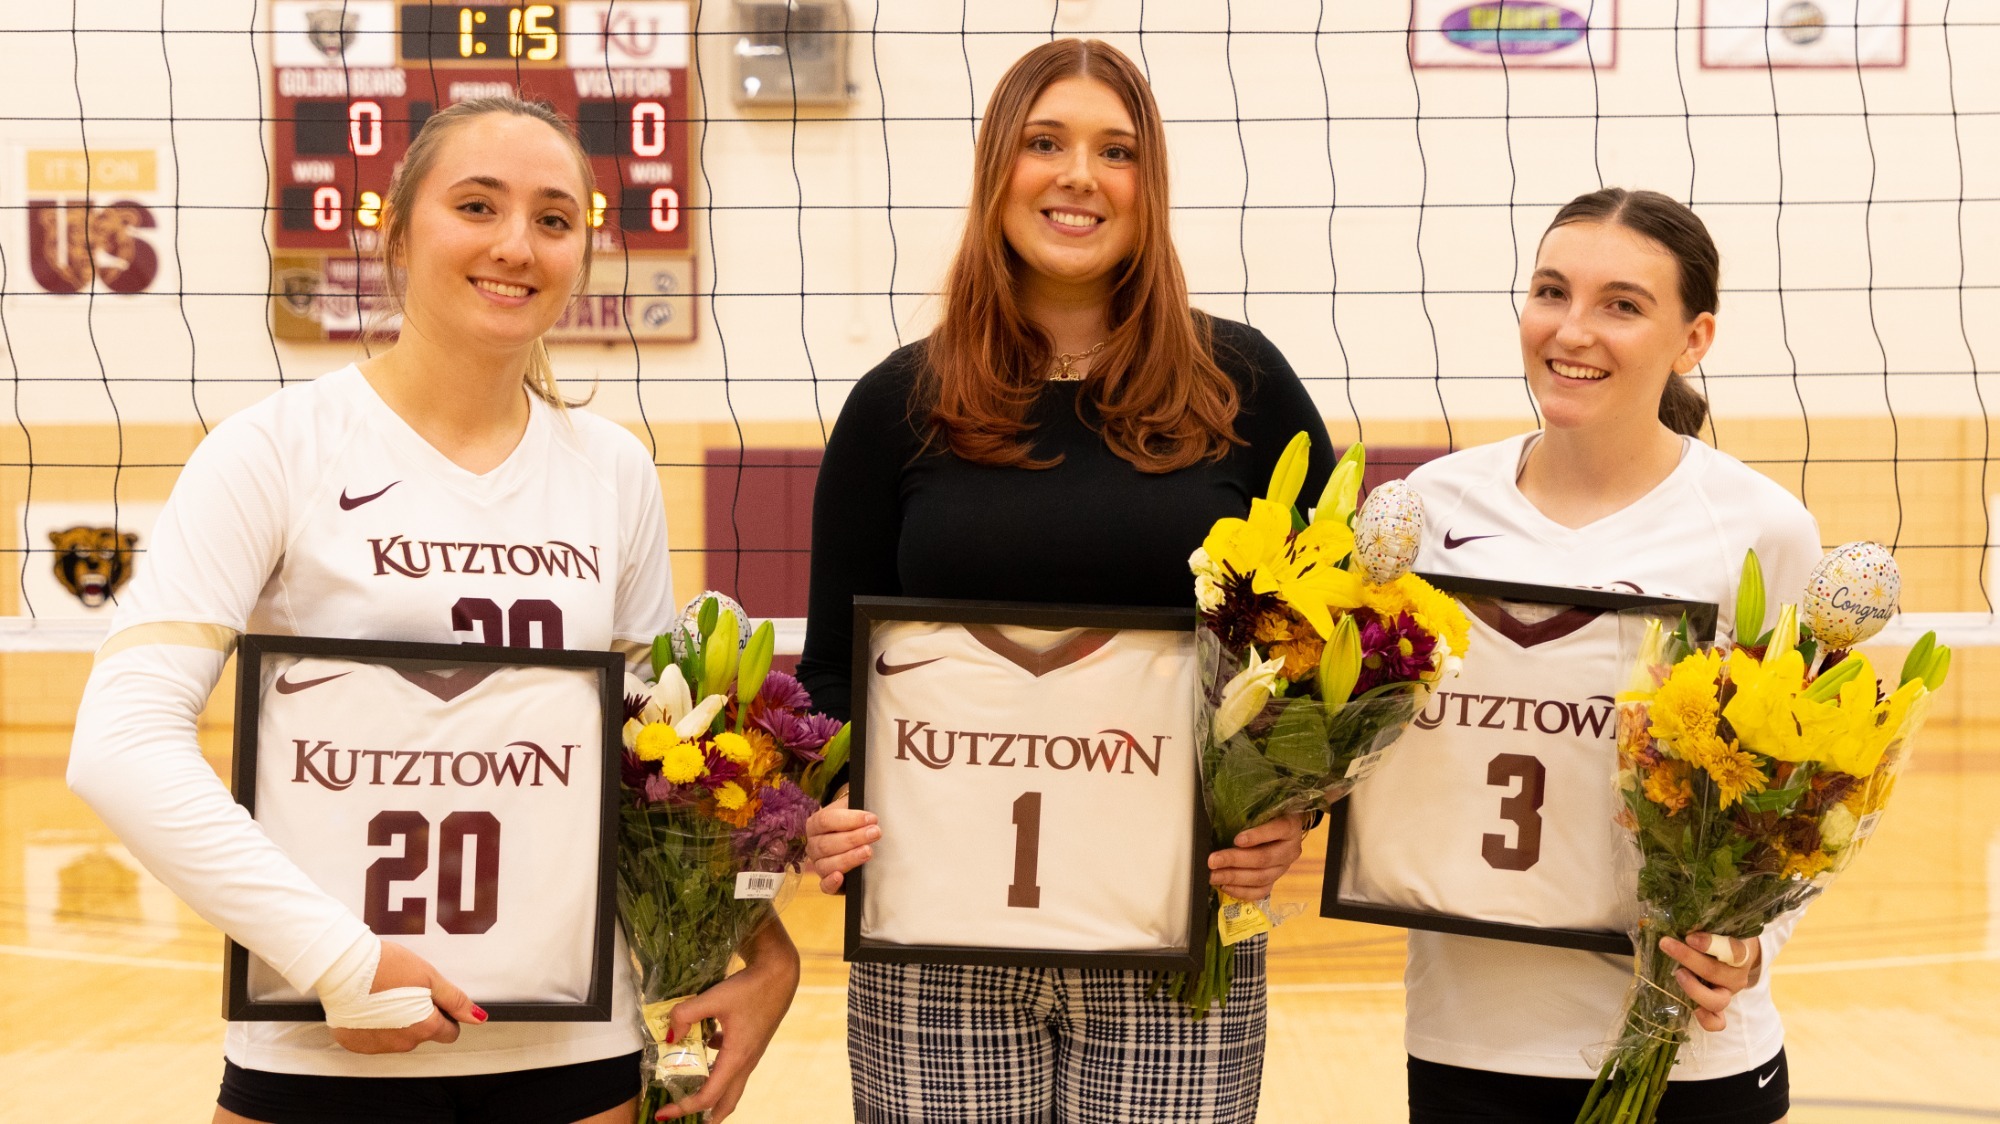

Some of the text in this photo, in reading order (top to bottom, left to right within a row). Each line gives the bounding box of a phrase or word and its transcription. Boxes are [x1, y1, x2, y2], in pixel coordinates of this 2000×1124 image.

[459, 4, 558, 60] 1:15
[597, 10, 659, 59] KU
[573, 70, 672, 98] VISITOR
[349, 101, 382, 156] 0
[631, 102, 665, 156] 0
[291, 161, 335, 183] WON
[630, 162, 673, 184] WON
[313, 187, 341, 231] 0
[651, 188, 679, 232] 0
[28, 200, 157, 294] US
[367, 535, 600, 583] KUTZTOWN
[1413, 691, 1616, 740] UTZTOW
[291, 739, 575, 792] KUTZTOWN
[894, 718, 1165, 777] KUTZTOWN
[1481, 752, 1546, 872] 3
[363, 810, 501, 935] 20
[1007, 791, 1042, 909] 1
